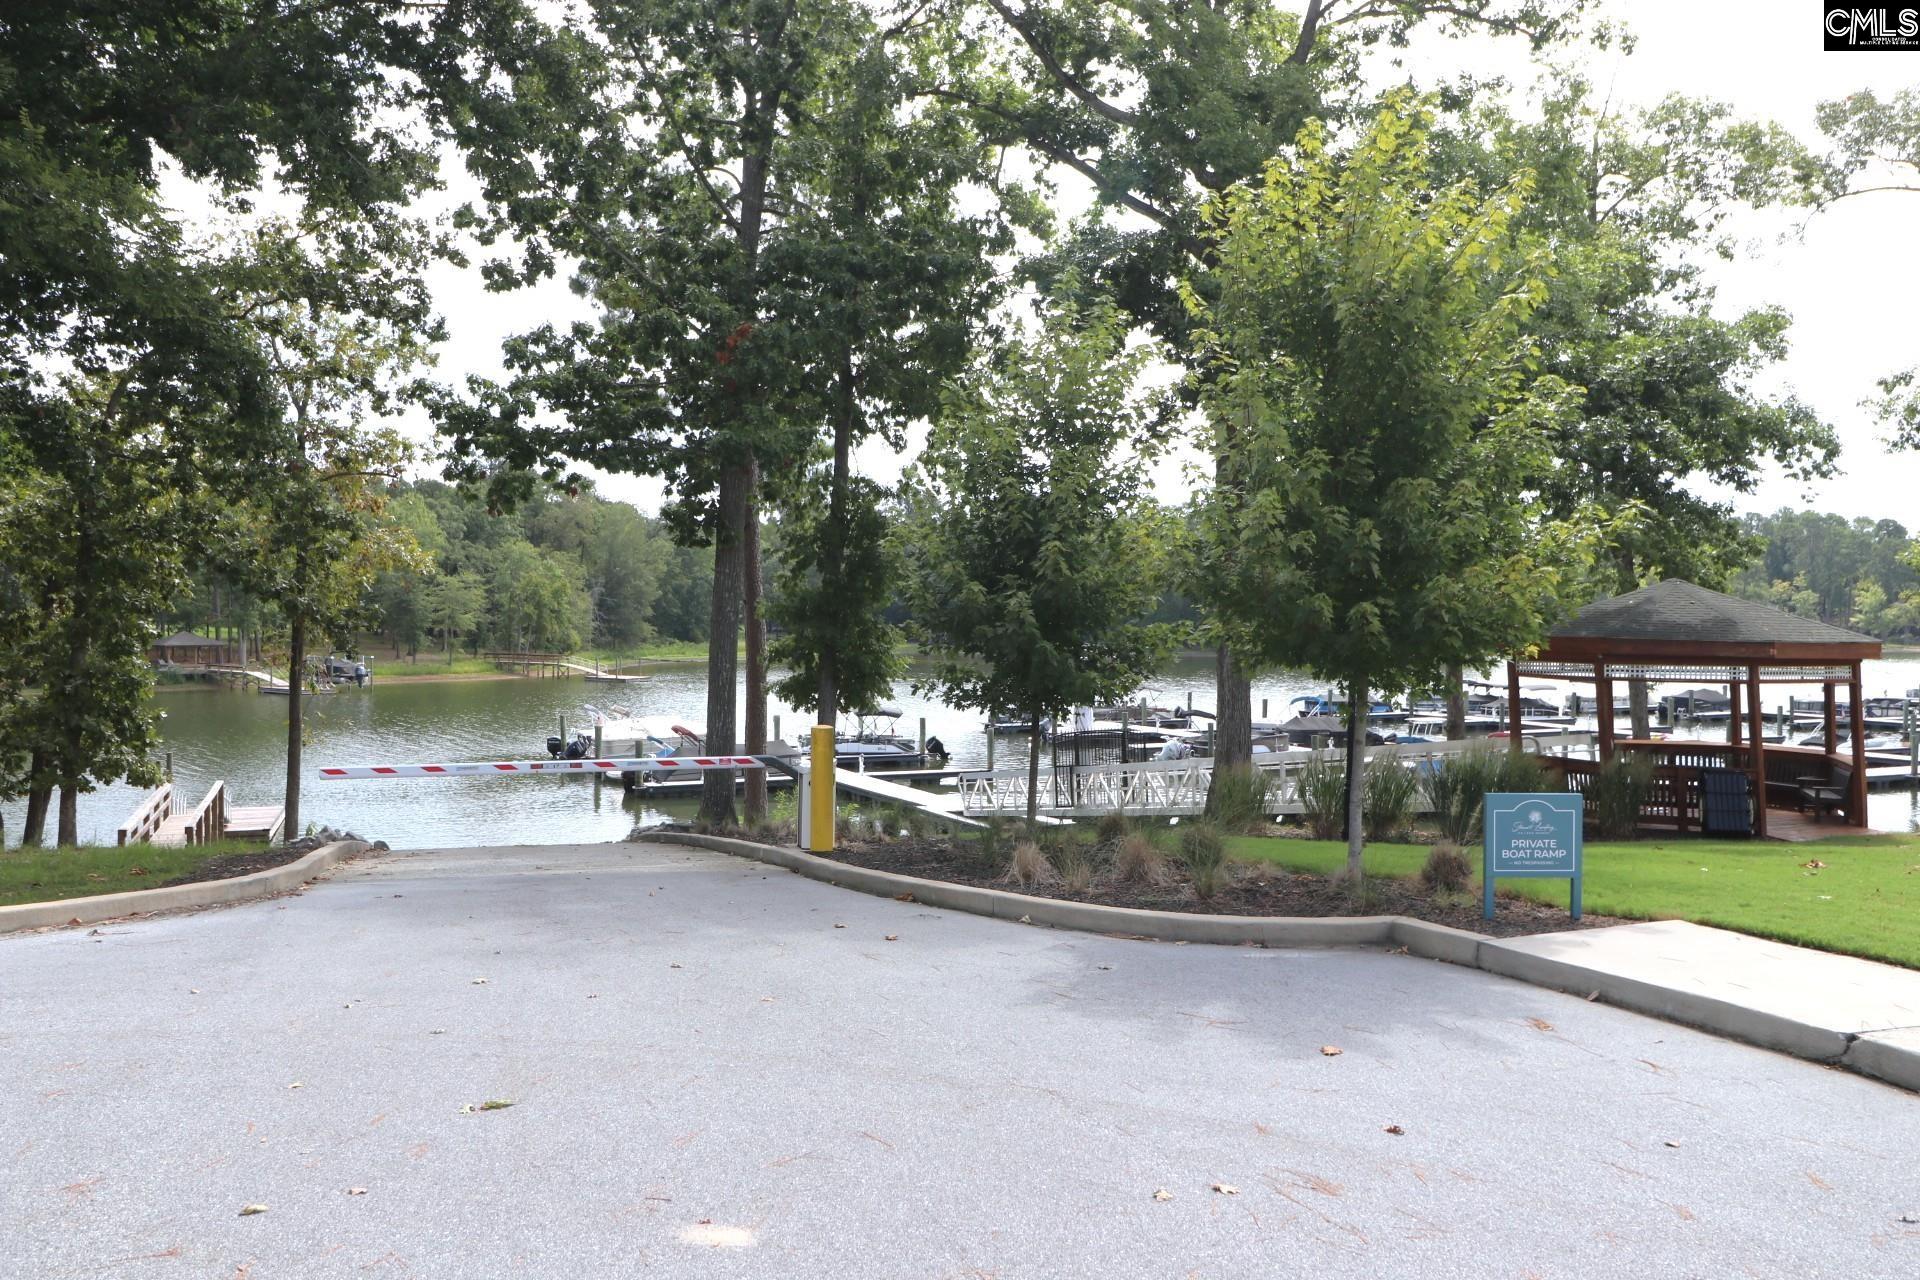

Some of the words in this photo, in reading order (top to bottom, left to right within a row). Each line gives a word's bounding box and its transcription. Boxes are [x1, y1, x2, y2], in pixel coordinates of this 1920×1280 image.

[1512, 840, 1557, 848] PRIVATE
[1502, 850, 1532, 858] BOAT
[1534, 850, 1566, 858] RAMP
